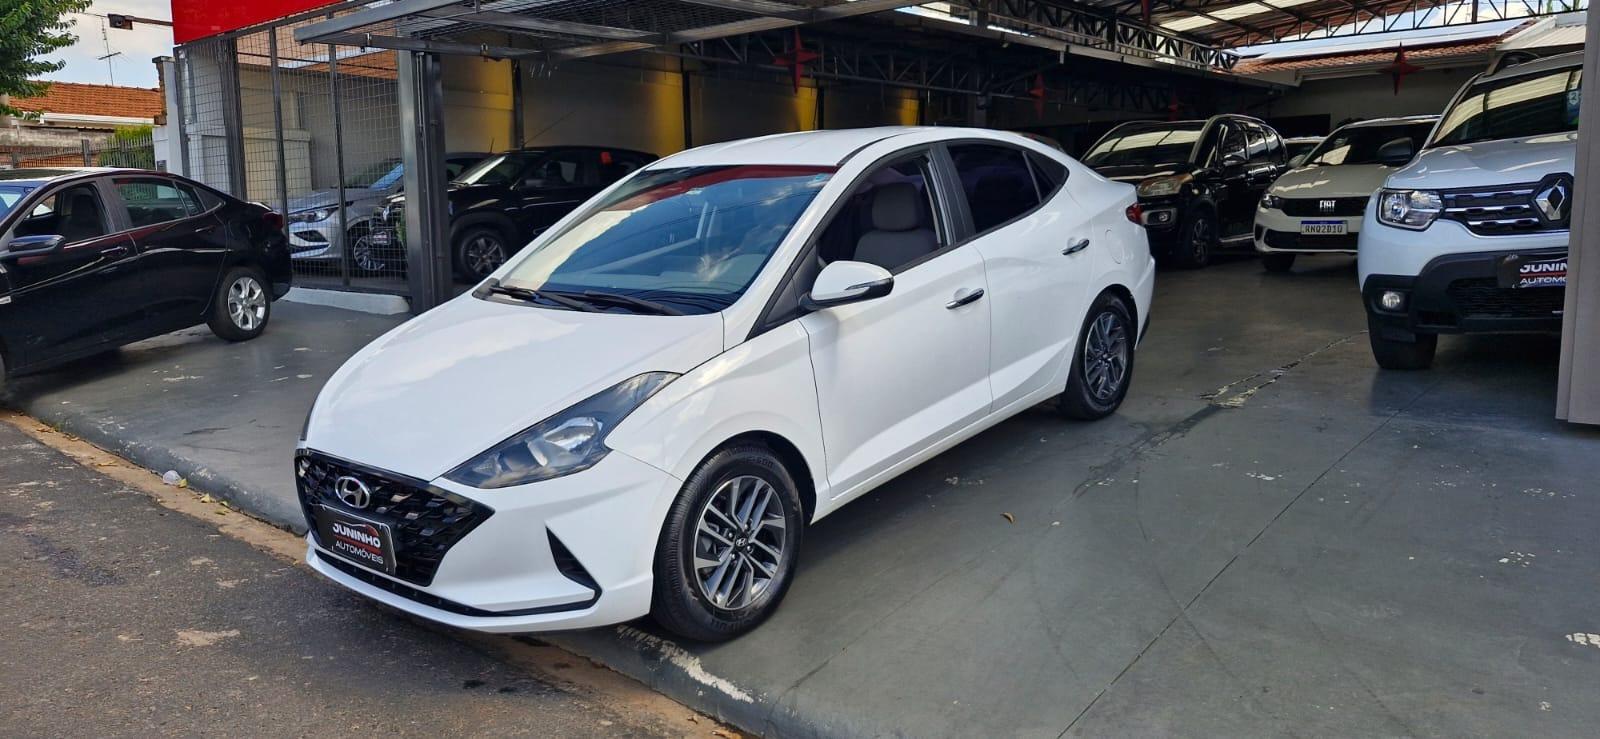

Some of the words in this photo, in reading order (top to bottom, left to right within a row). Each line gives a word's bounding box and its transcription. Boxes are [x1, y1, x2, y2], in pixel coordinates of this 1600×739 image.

[1320, 200, 1336, 209] FIAT
[1520, 262, 1568, 273] JUNIN
[332, 523, 381, 548] JUNINHO
[335, 540, 384, 565] AUTOMÓVEIS
